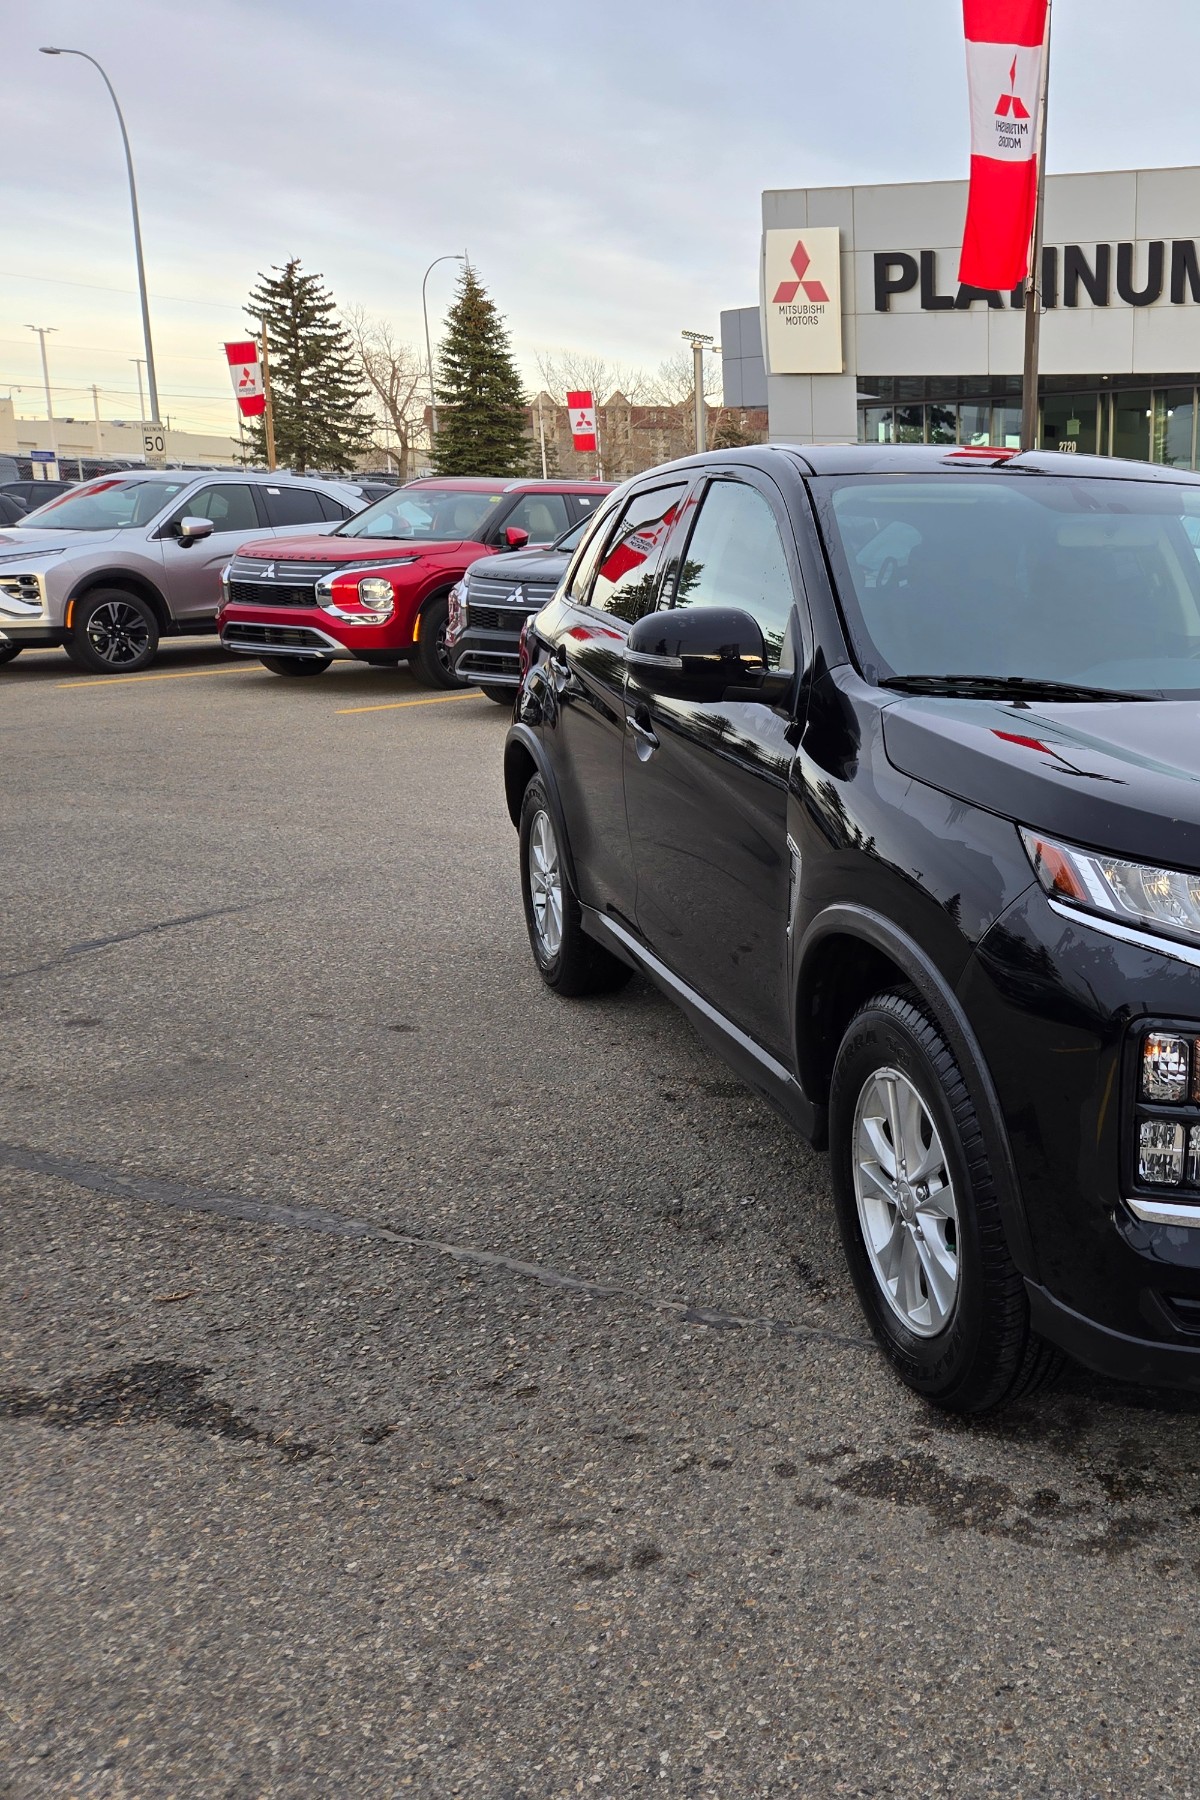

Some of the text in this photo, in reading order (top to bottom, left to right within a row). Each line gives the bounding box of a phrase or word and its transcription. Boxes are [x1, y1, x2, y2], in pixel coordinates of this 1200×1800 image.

[778, 304, 825, 315] MITSUBISHI
[785, 315, 819, 326] MOTORS
[144, 436, 164, 452] 50
[1058, 441, 1077, 453] 2720
